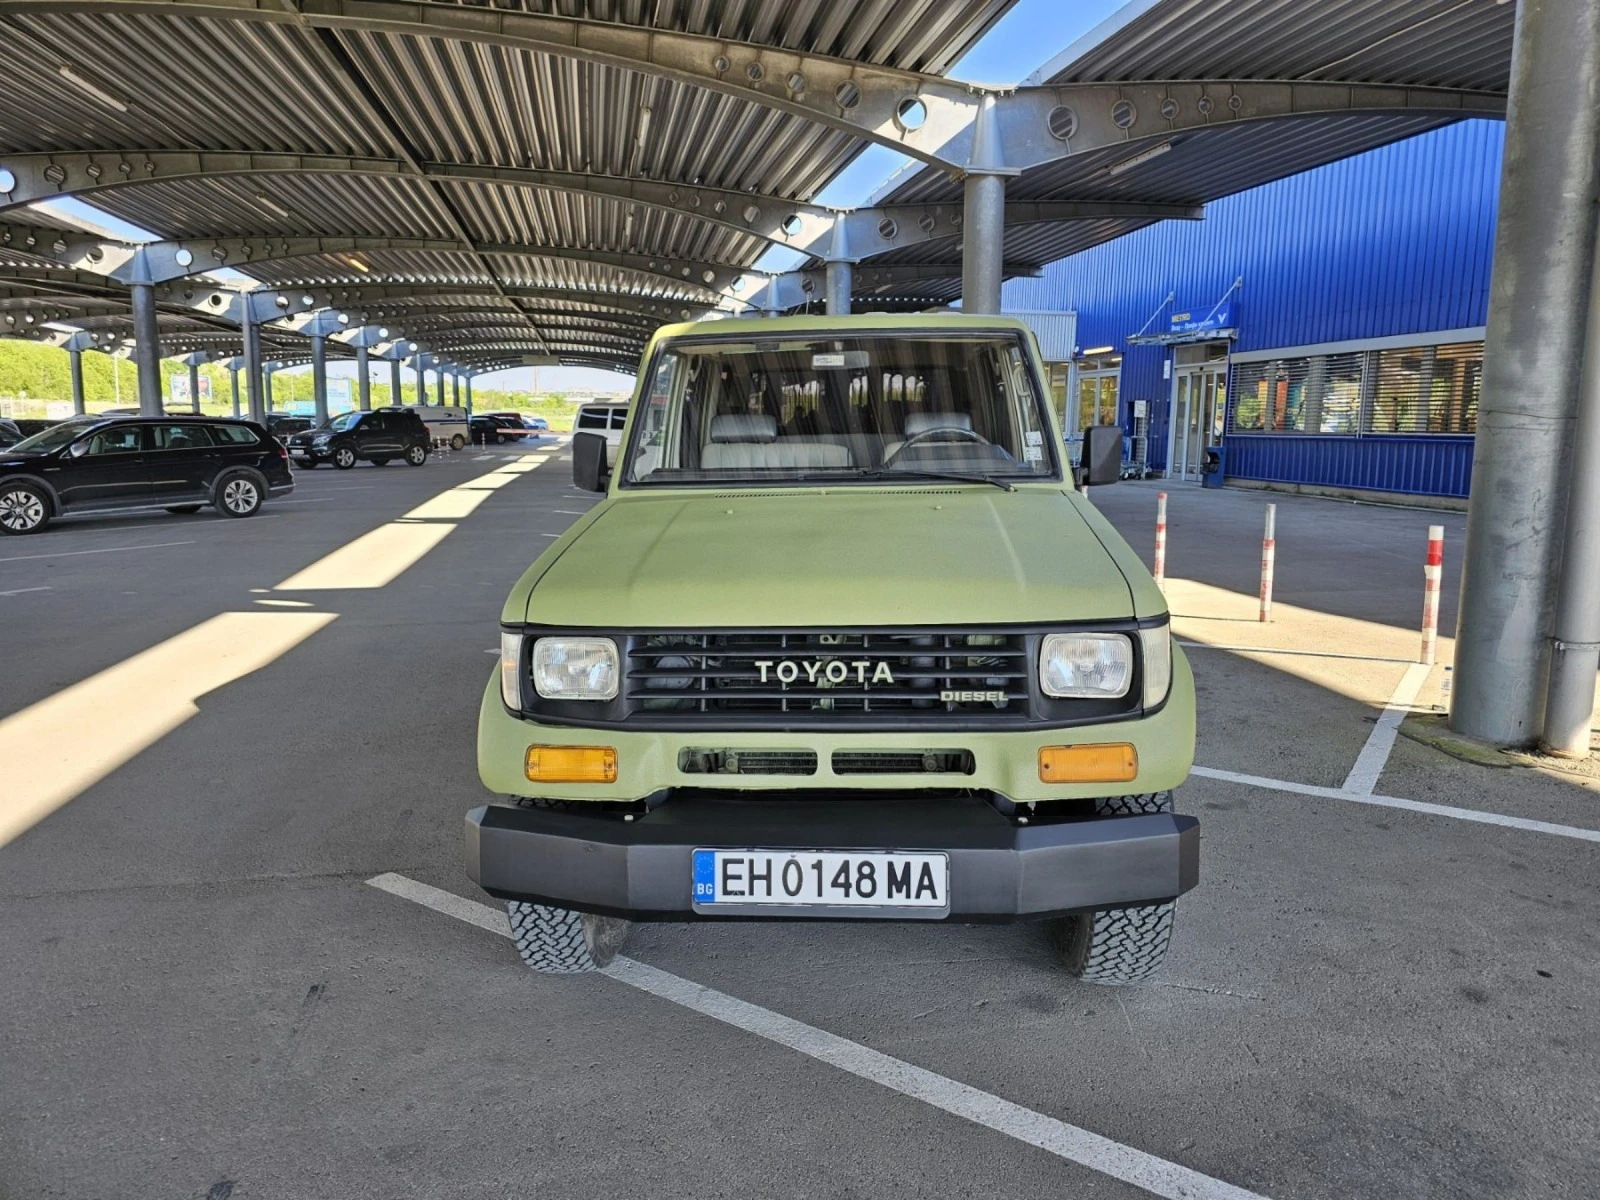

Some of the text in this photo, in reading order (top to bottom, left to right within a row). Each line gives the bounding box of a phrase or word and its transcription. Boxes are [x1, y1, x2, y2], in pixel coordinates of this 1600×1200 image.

[1171, 313, 1191, 323] METRO
[754, 660, 894, 684] TOYOTA
[940, 690, 1009, 702] DIESEL
[697, 883, 713, 895] BG
